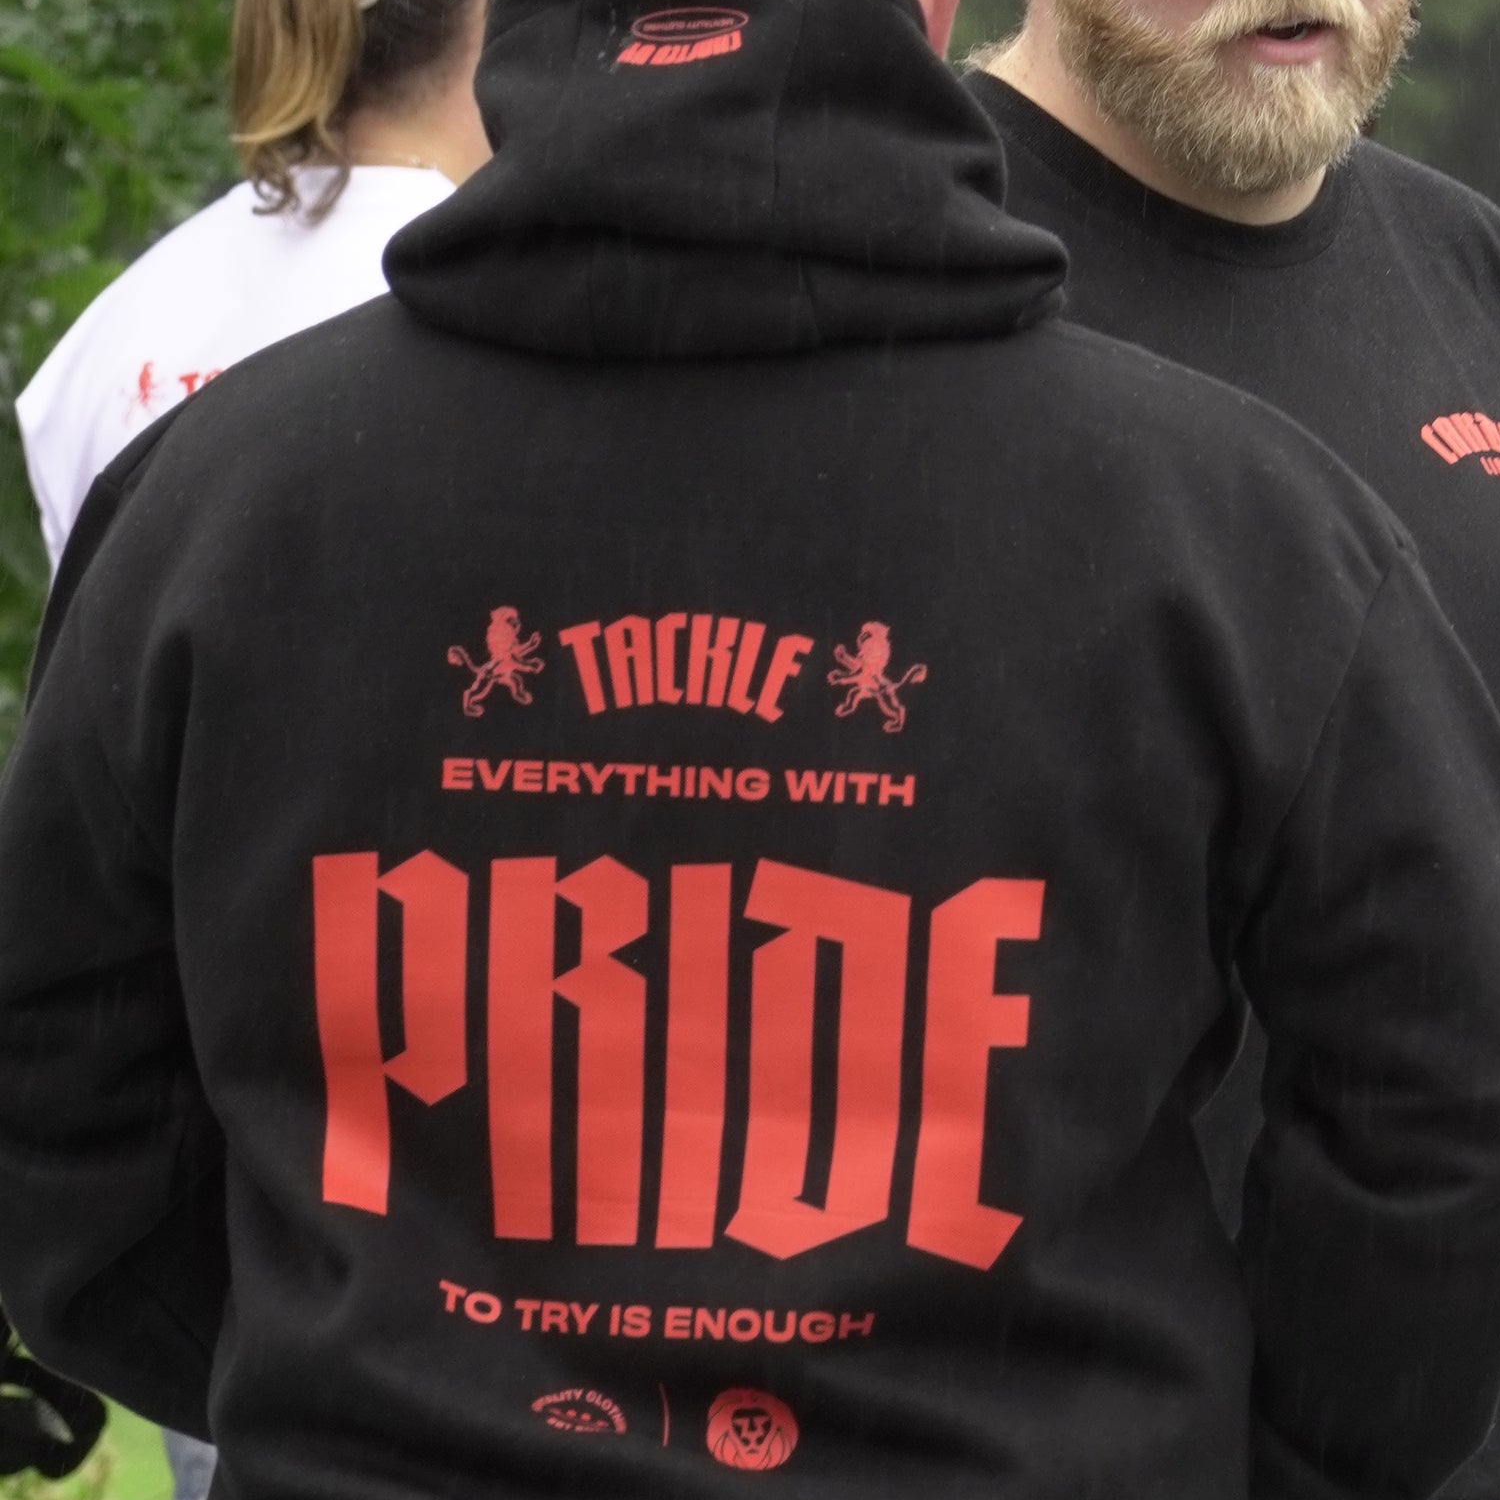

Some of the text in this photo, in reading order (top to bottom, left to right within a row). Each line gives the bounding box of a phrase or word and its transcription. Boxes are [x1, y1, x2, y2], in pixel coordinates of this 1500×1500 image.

[558, 612, 815, 723] TACKLE
[441, 757, 916, 808] EVERYTHING WITH
[311, 849, 1047, 1272] PRIDE
[437, 1280, 876, 1346] TO TRY IS ENOUGH
